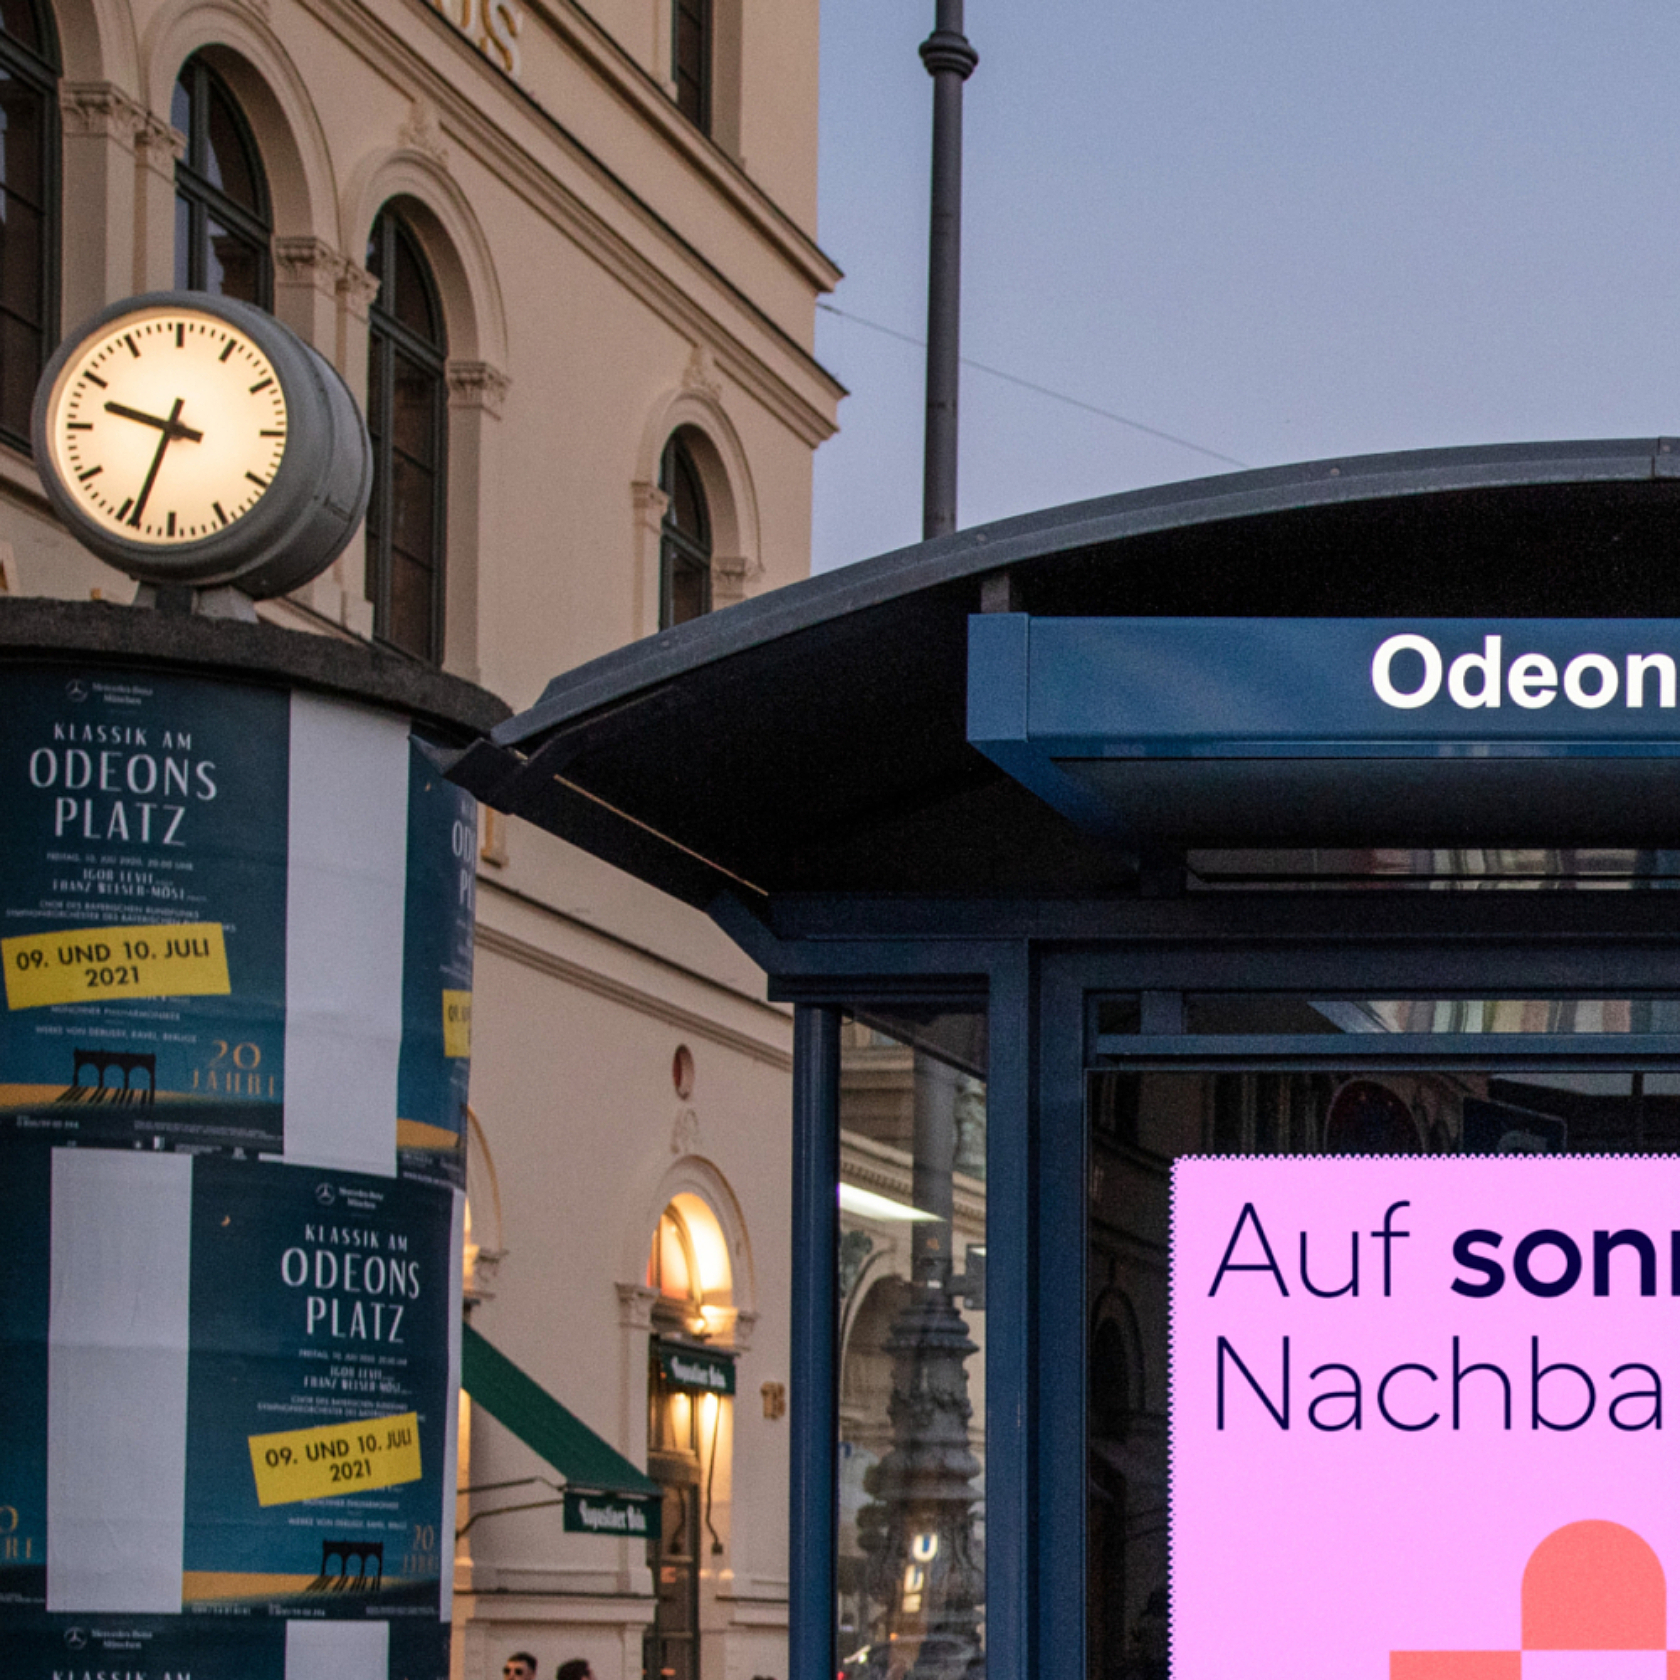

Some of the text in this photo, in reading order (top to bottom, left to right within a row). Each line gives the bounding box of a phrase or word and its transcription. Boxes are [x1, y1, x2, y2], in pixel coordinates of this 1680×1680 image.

[53, 722, 193, 751] KLASSIK AM
[29, 747, 218, 801] ODEONS
[55, 796, 187, 847] PLATZ
[16, 938, 211, 971] 09. UND 10. JULI
[85, 966, 140, 988] 2021
[209, 1039, 262, 1071] 20
[304, 1223, 408, 1252] KLASSIK AM
[1207, 1199, 1411, 1299] Auf
[281, 1247, 420, 1299] ODEONS
[306, 1296, 404, 1343] PLATZ
[265, 1427, 412, 1468] 09. UND 10. JULI
[329, 1459, 372, 1483] 2021
